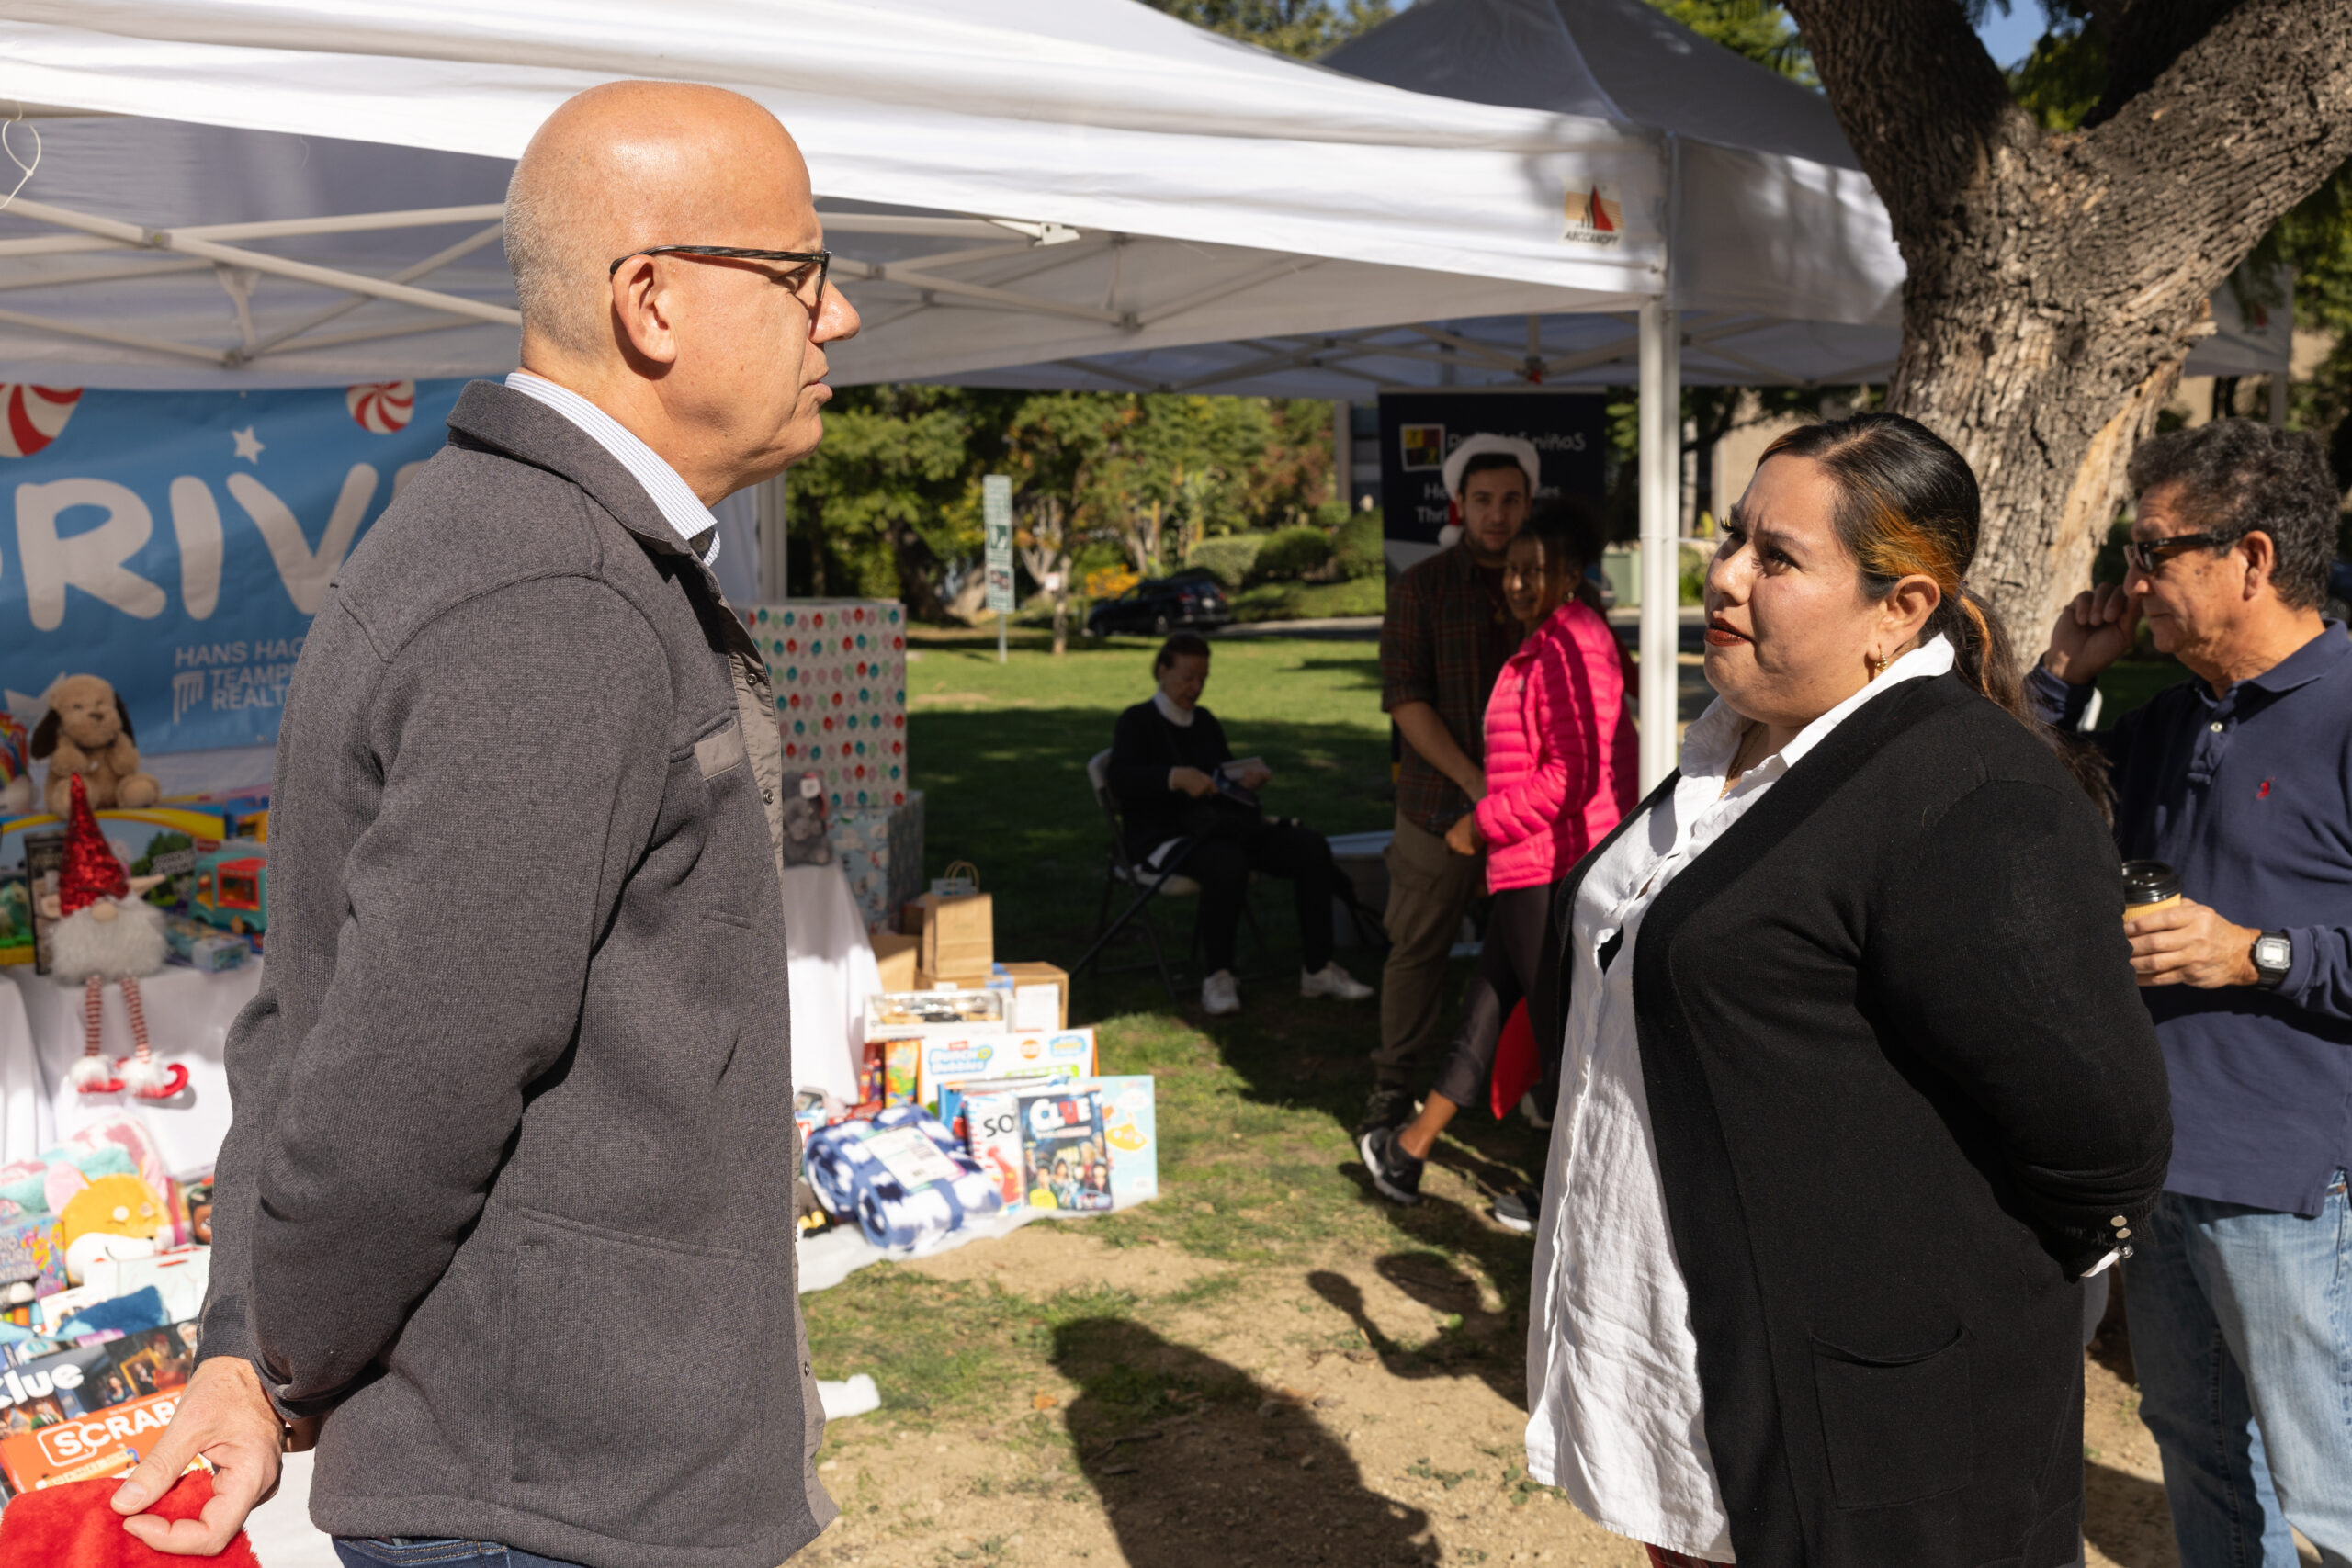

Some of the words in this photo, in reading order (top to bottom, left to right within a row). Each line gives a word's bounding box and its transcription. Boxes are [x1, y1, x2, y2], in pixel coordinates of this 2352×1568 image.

[13, 461, 434, 631] RIV
[175, 641, 248, 669] HANS
[209, 663, 297, 688] TEAMP
[211, 683, 288, 711] REALT
[983, 1114, 1015, 1138] SO
[1029, 1096, 1092, 1132] CLUE
[53, 1395, 182, 1457] SCRAB
